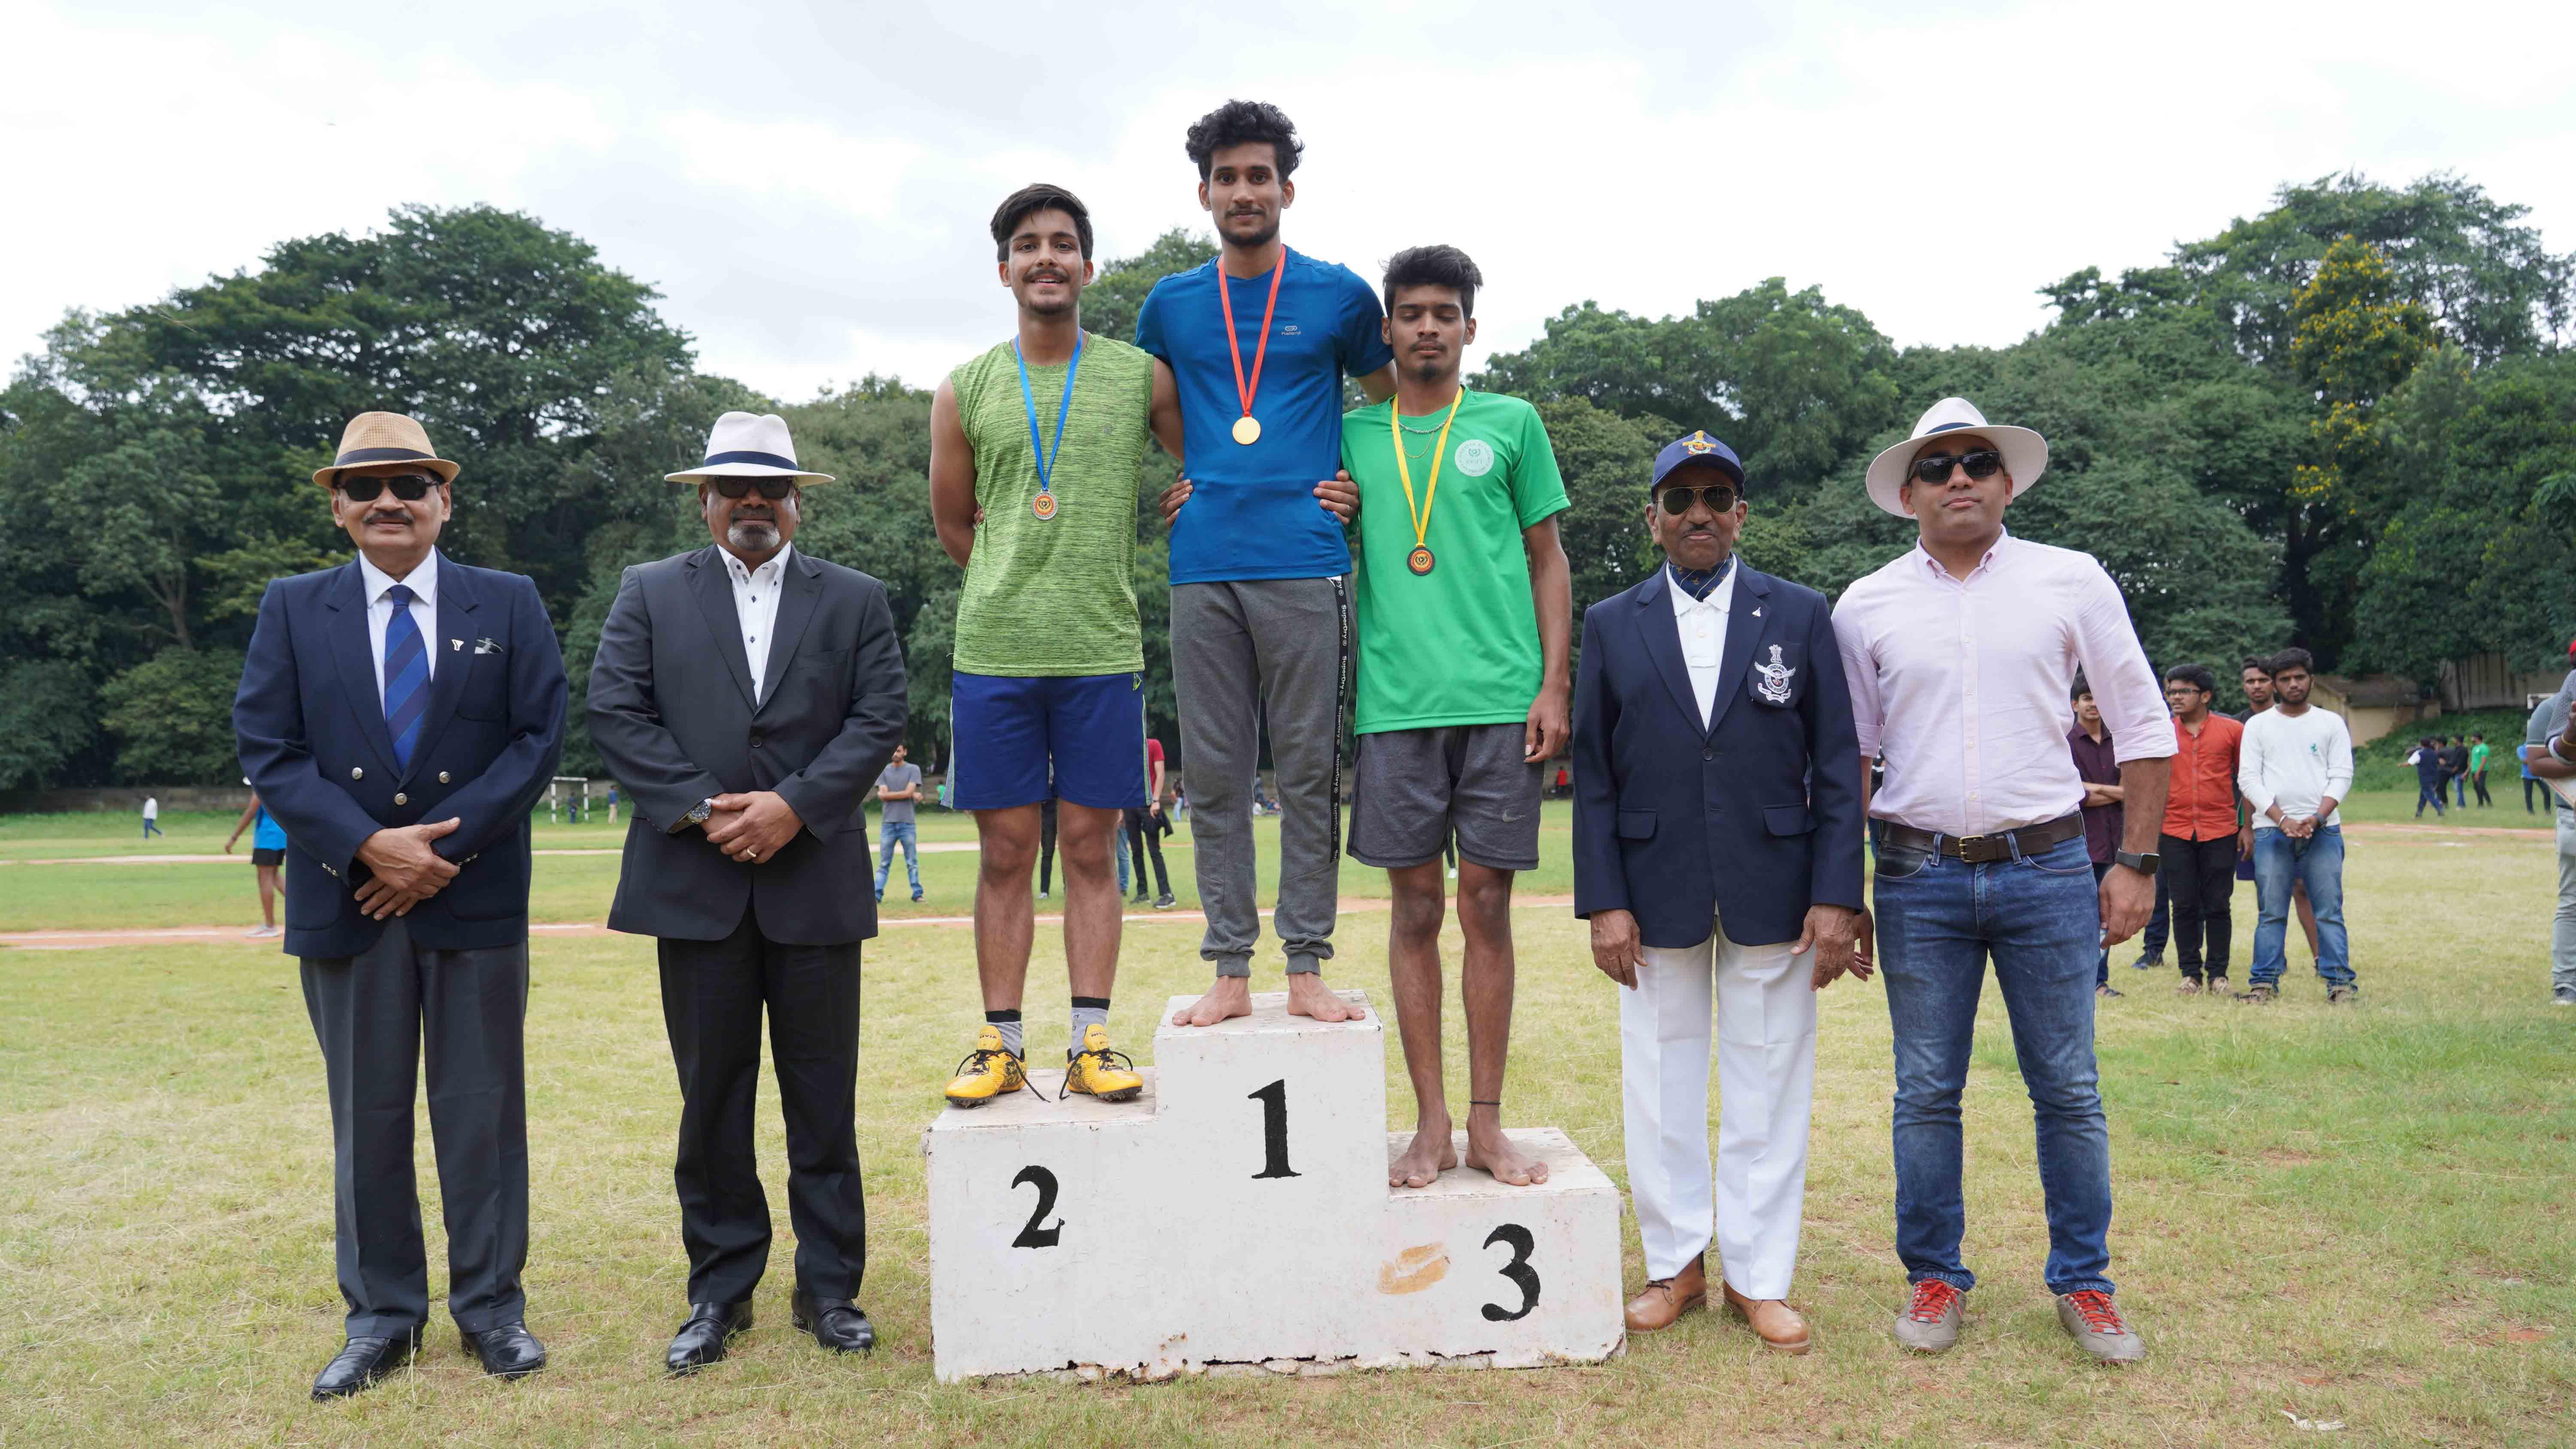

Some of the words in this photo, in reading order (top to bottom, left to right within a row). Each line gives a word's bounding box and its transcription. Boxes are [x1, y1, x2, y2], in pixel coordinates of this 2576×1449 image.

[1248, 1079, 1302, 1179] 1
[1012, 1166, 1065, 1249] 2
[1482, 1224, 1540, 1321] 3
